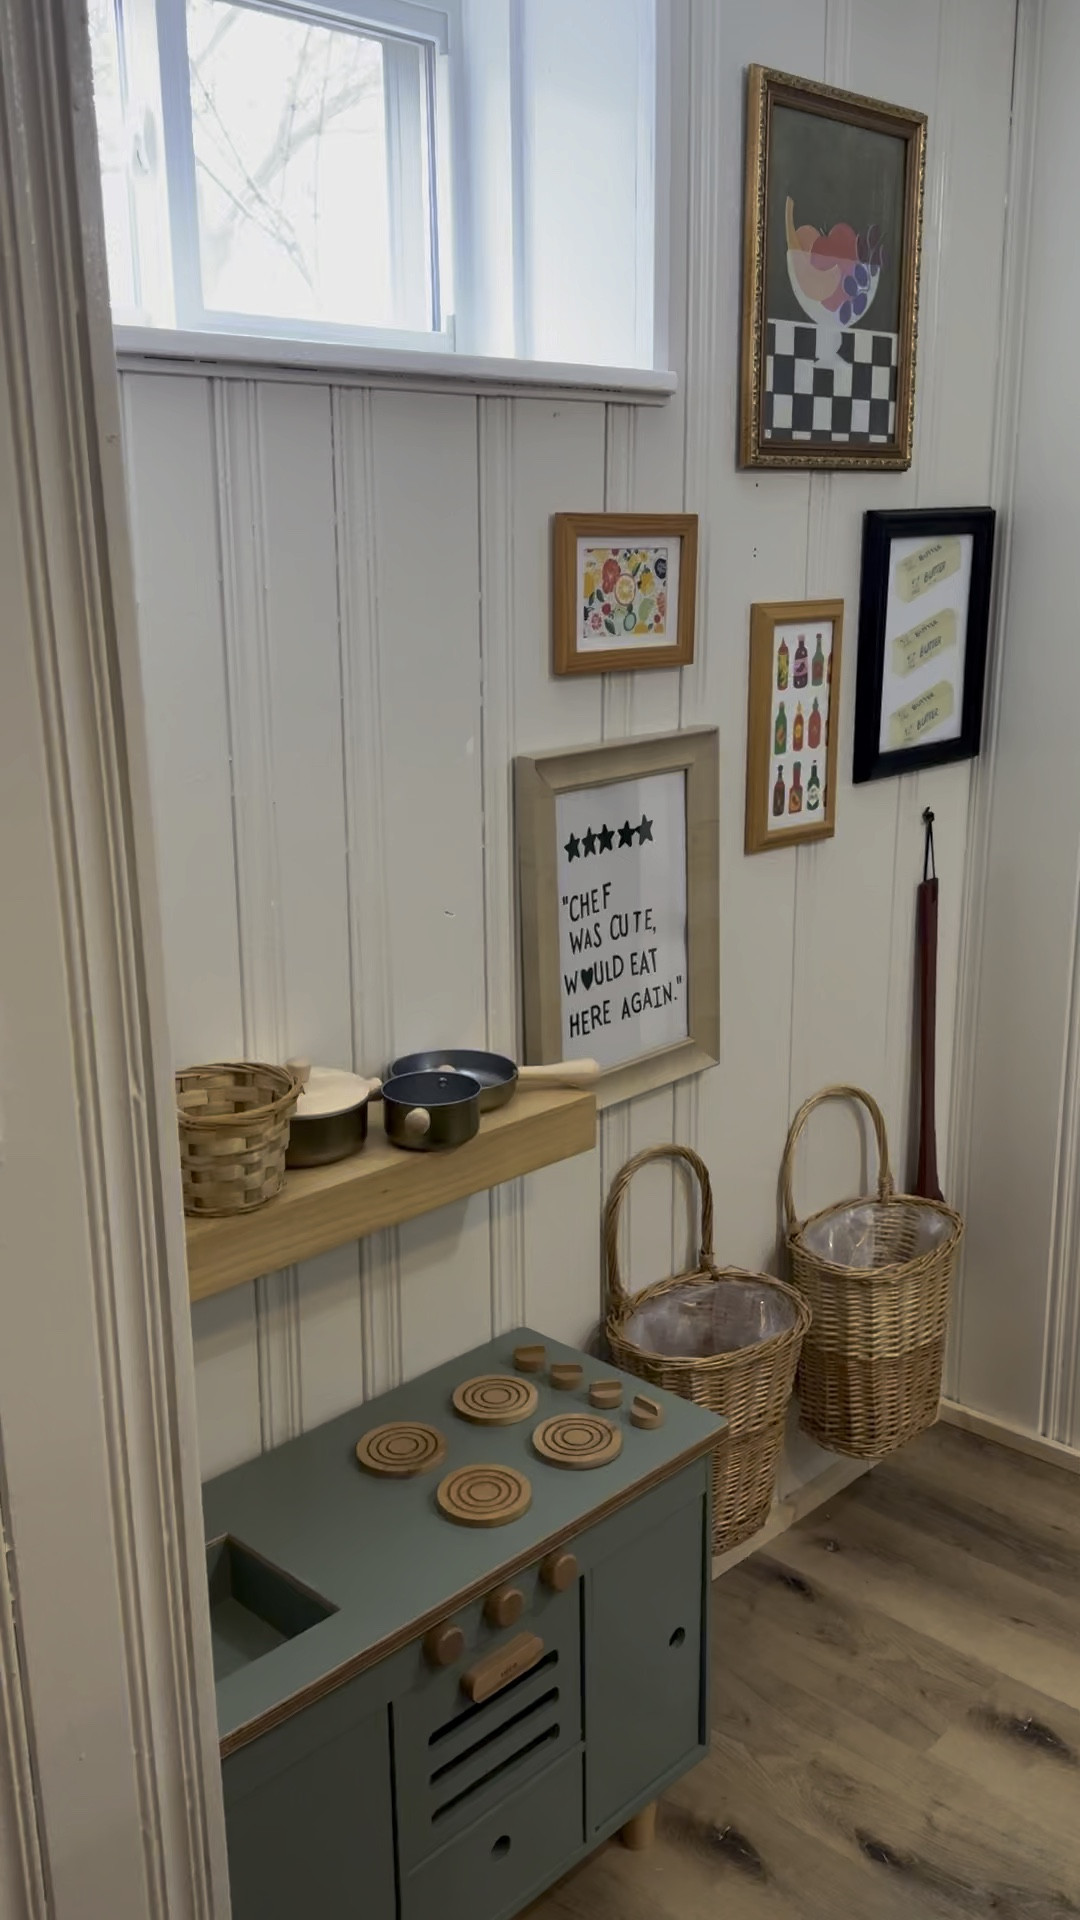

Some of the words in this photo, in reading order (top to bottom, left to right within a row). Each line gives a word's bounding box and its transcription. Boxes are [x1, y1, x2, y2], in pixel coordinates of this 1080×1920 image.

[562, 882, 612, 922] "CHEF
[569, 922, 602, 955] WAS
[610, 908, 656, 940] CUTE,
[630, 948, 657, 976] EAT
[569, 1000, 611, 1038] HERE
[621, 975, 682, 1020] AGAIN."
